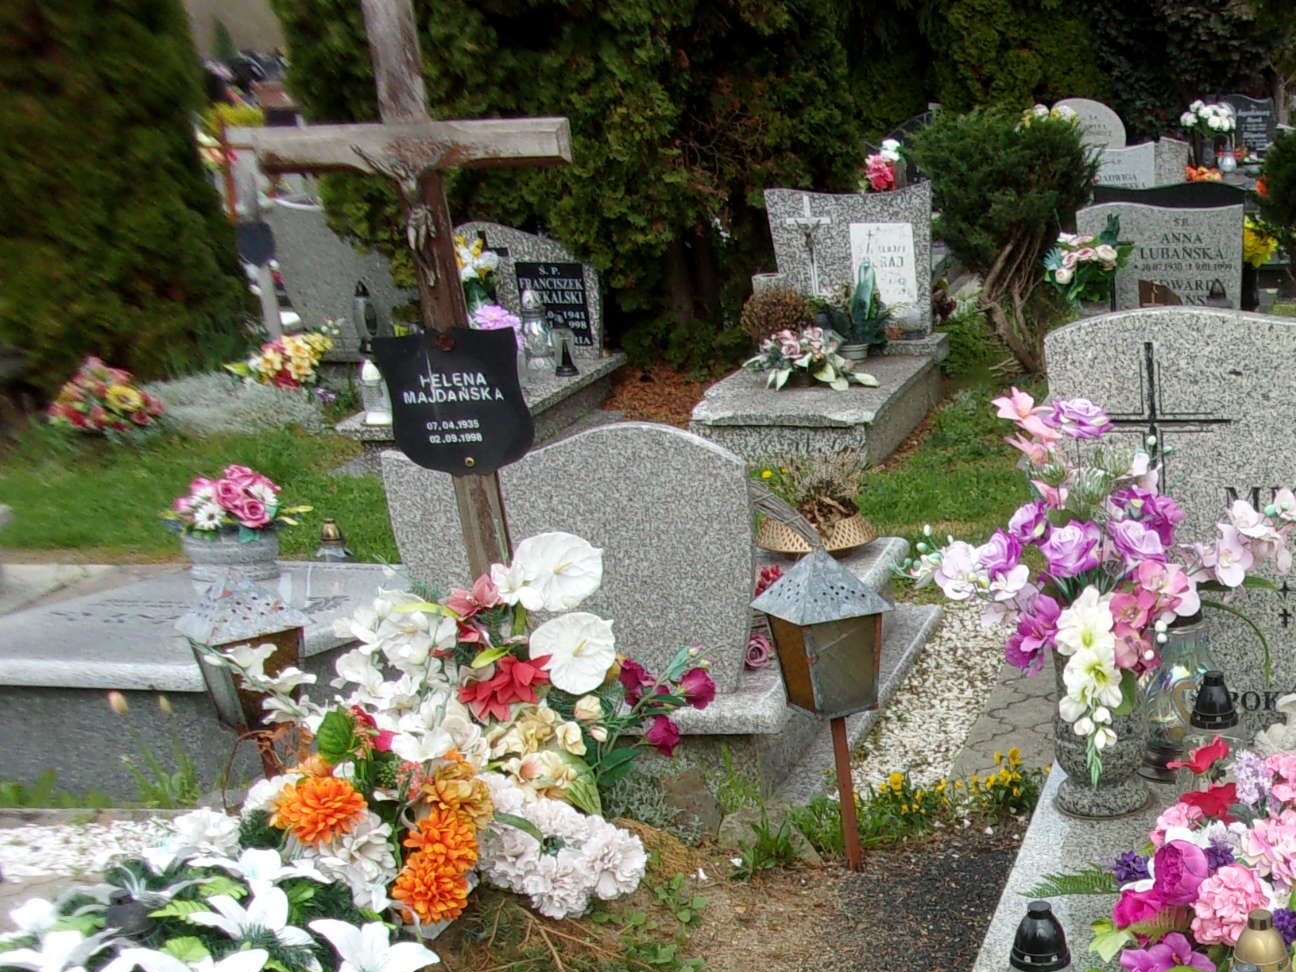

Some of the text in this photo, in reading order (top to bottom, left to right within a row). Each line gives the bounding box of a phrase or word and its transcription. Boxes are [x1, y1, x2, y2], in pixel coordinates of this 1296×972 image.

[1161, 232, 1203, 244] ANNA
[1140, 246, 1225, 260] LUBAŃSKA
[518, 278, 583, 291] FRANCISZEK
[420, 372, 487, 388] HELENA
[403, 385, 504, 404] MAJDAŃSKA
